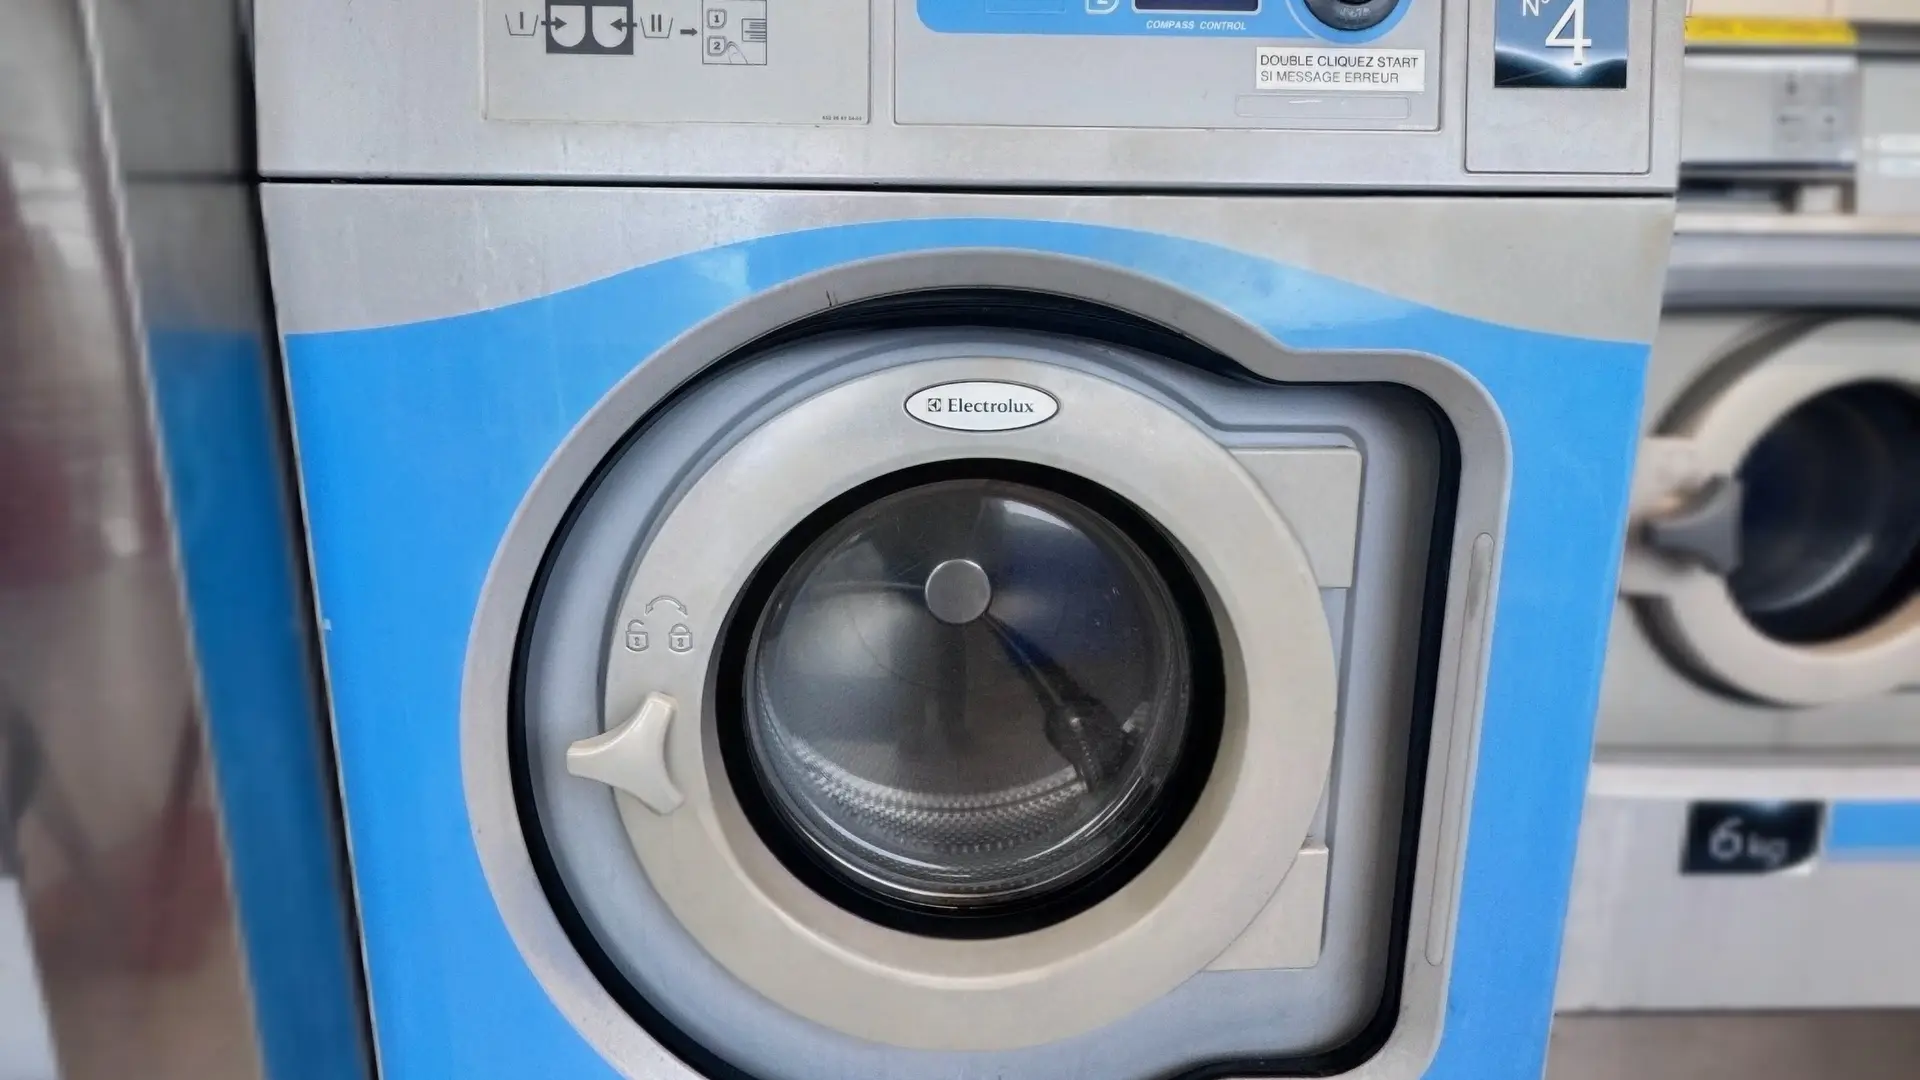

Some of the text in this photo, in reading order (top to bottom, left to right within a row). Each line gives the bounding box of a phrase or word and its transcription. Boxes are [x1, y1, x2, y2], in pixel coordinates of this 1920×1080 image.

[714, 14, 720, 23] 1
[1146, 20, 1247, 31] COMPASS CONTROL
[1545, 0, 1592, 63] 4
[713, 41, 721, 50] 2
[1260, 54, 1419, 68] DOUBLE CLIQUEZ START
[1260, 70, 1399, 84] SI MESSAGE ERREUR
[948, 398, 1034, 413] Electrolux
[1708, 816, 1744, 862] 6
